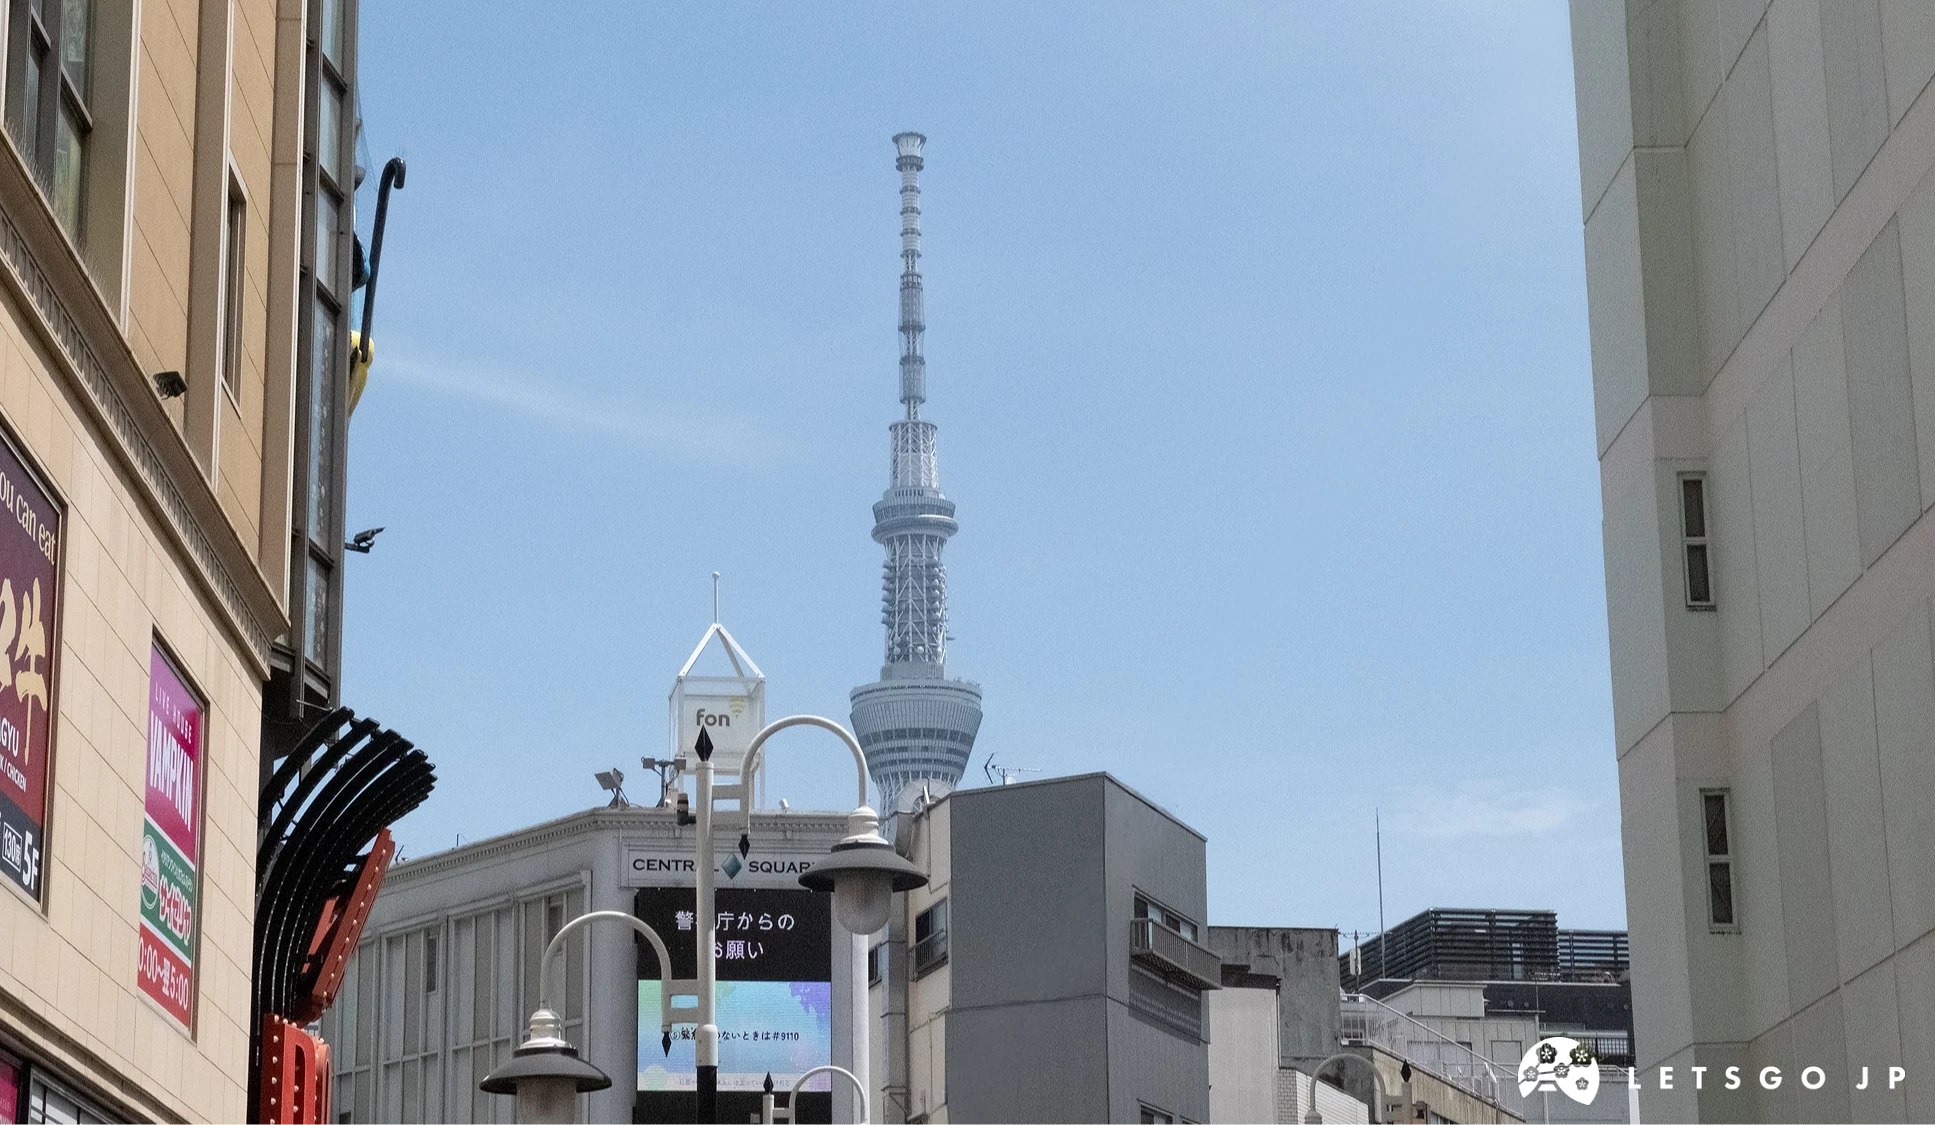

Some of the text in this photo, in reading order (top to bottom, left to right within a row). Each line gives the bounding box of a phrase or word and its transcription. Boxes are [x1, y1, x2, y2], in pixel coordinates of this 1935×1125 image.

[0, 469, 56, 566] ou can eat
[155, 680, 170, 716] LIVE
[696, 708, 731, 727] fon
[0, 717, 20, 758] GYU
[7, 762, 27, 793] CHICKEN
[150, 709, 194, 833] VAMPKIN
[22, 830, 40, 891] 5F
[632, 858, 815, 874] CENTR SQUAR
[675, 910, 795, 931] 警庁からの
